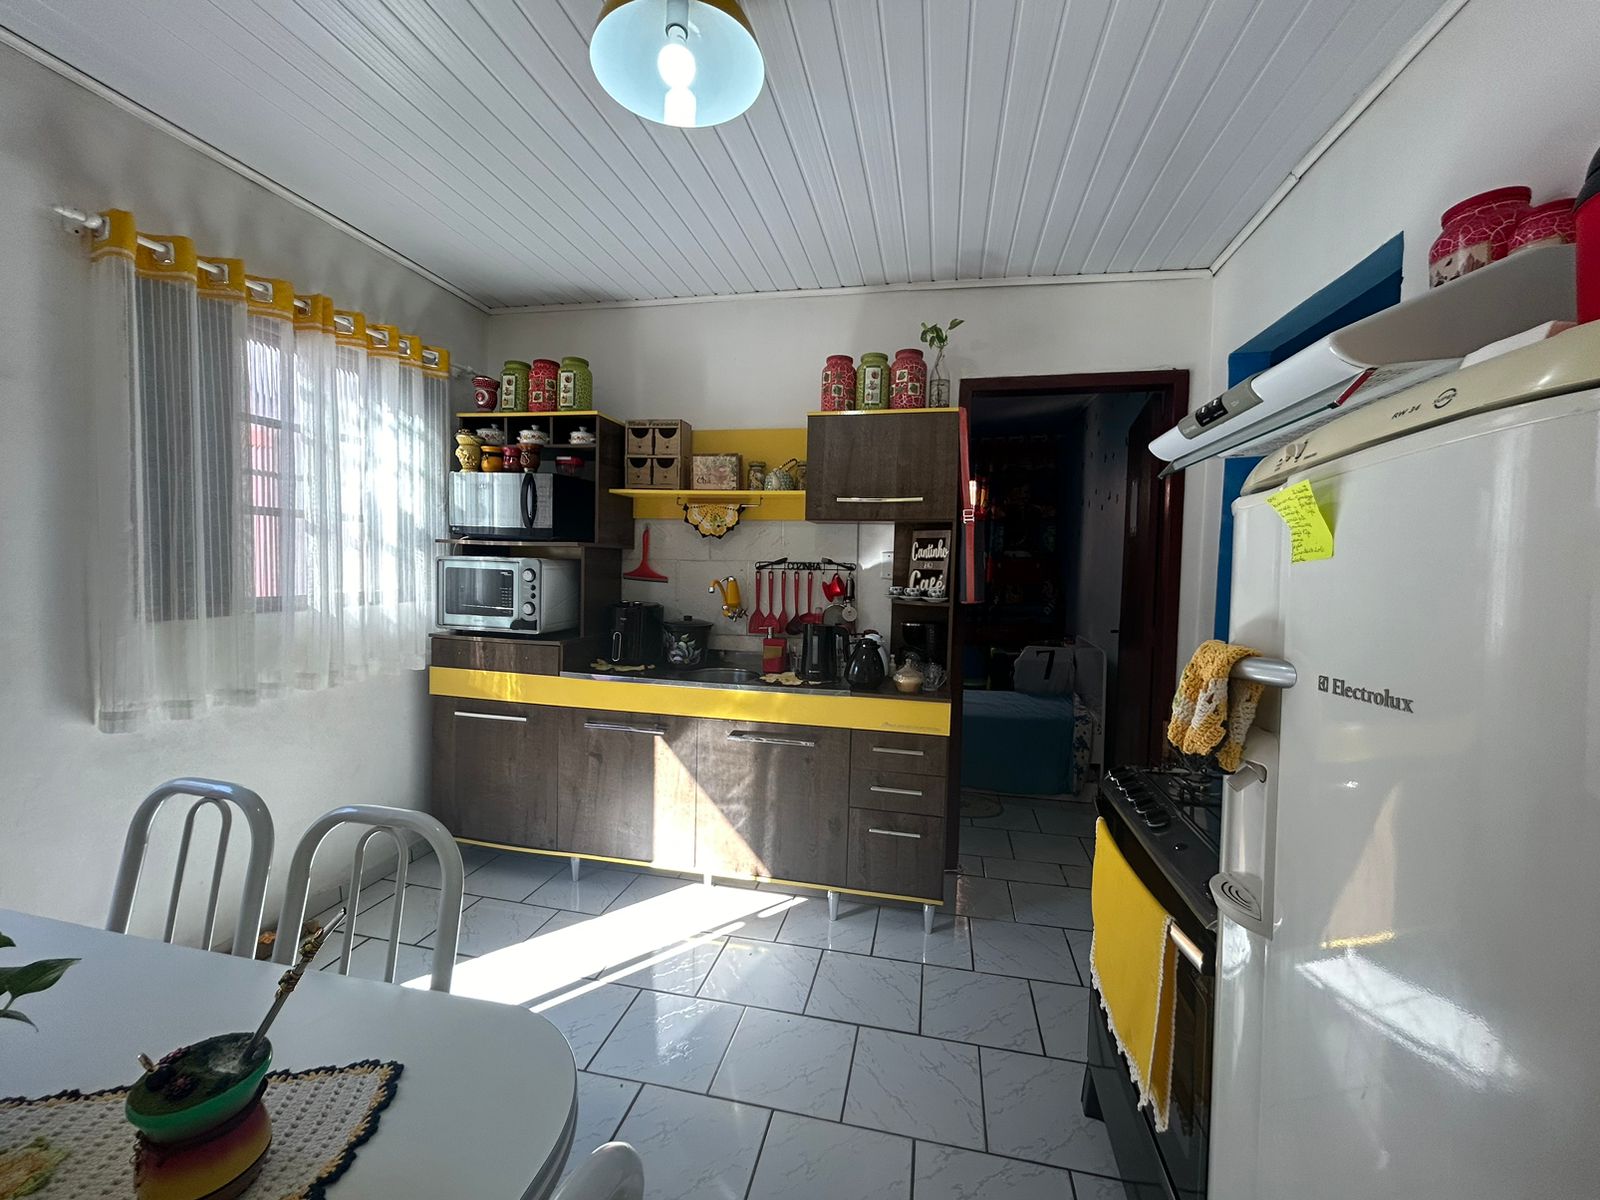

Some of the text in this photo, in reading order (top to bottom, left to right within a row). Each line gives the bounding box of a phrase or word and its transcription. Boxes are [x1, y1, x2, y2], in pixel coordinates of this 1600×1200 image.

[912, 539, 949, 561] Cantinho
[787, 562, 821, 570] COZINHA
[1332, 678, 1414, 714] Electrolux
